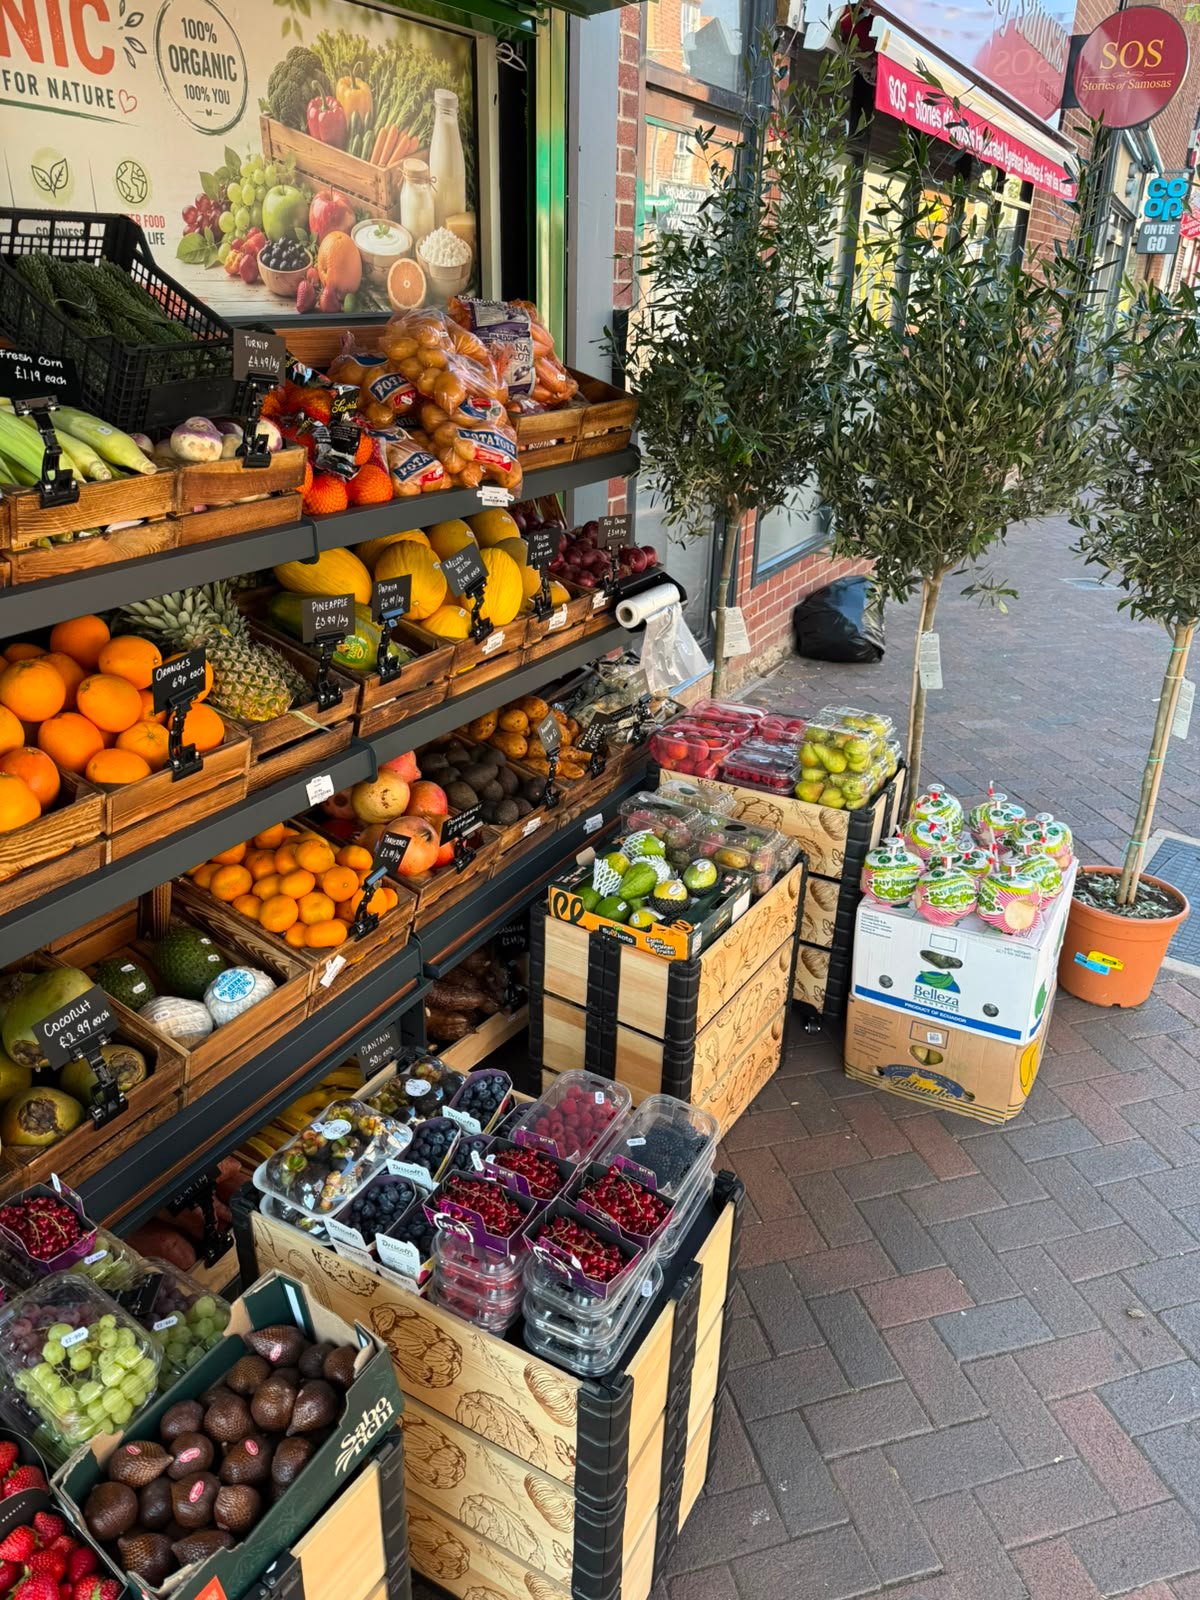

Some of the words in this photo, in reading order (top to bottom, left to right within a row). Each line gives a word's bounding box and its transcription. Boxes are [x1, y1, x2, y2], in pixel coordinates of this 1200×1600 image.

[181, 17, 217, 44] 100%
[168, 44, 237, 82] ORGANIC
[1100, 39, 1164, 70] SOS
[3, 69, 38, 96] FOR
[47, 78, 116, 109] NATURE
[184, 84, 209, 101] 100%
[211, 88, 230, 105] YOU
[888, 75, 907, 113] SOS
[1082, 80, 1116, 91] Stories
[1116, 80, 1125, 91] of
[1127, 79, 1172, 89] Samosas
[144, 214, 165, 228] FOOD
[1144, 224, 1159, 235] ON
[1159, 224, 1176, 235] THE
[149, 231, 165, 245] LIFE
[1147, 236, 1167, 252] GO
[244, 335, 269, 350] TURNIP
[38, 356, 63, 369] Corn
[14, 365, 41, 382] £1.19
[45, 374, 67, 385] each
[311, 598, 348, 613] PINEAPPLE
[156, 658, 190, 681] ORANGES
[172, 674, 187, 688] 69p
[190, 665, 204, 679] each
[913, 984, 960, 1007] Belleza
[913, 997, 960, 1013] PLANTAINS
[43, 1000, 91, 1037] Coconut
[904, 1003, 931, 1015] PRODUCT
[939, 1011, 967, 1025] ECUADOR
[59, 1019, 91, 1049] £2.99
[92, 1010, 110, 1027] each
[361, 1031, 390, 1056] PLANTAIN
[381, 1239, 414, 1259] Driscoll's
[340, 1396, 387, 1450] Sabo
